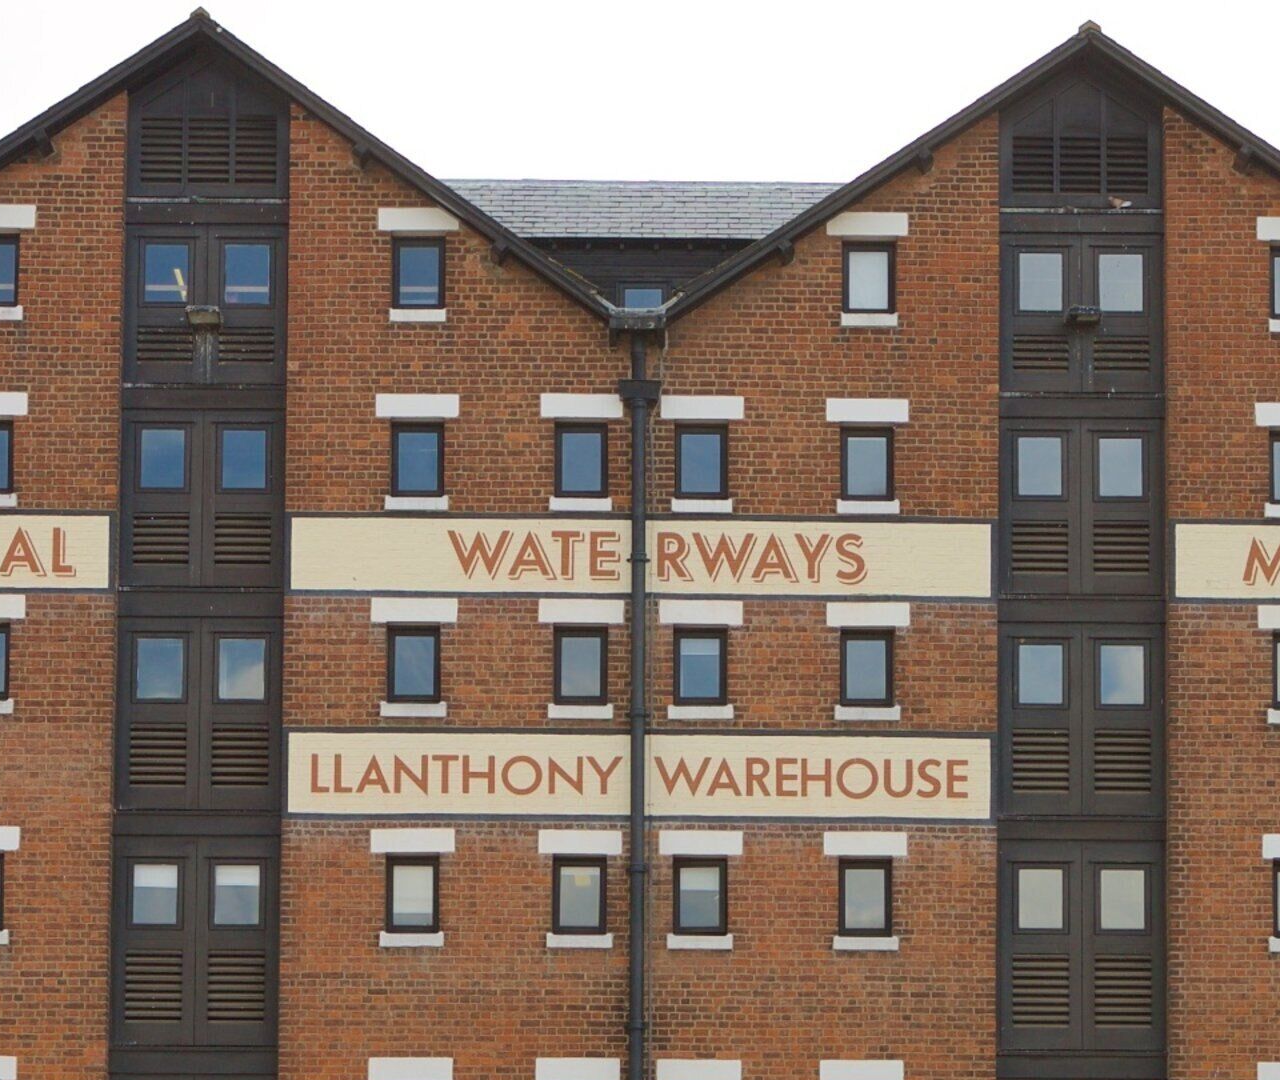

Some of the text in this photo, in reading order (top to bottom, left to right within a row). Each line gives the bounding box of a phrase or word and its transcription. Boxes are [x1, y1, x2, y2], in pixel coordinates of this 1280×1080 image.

[447, 529, 869, 585] WATERWAYS
[310, 753, 969, 799] LLANTHONY WAREHOUSE
